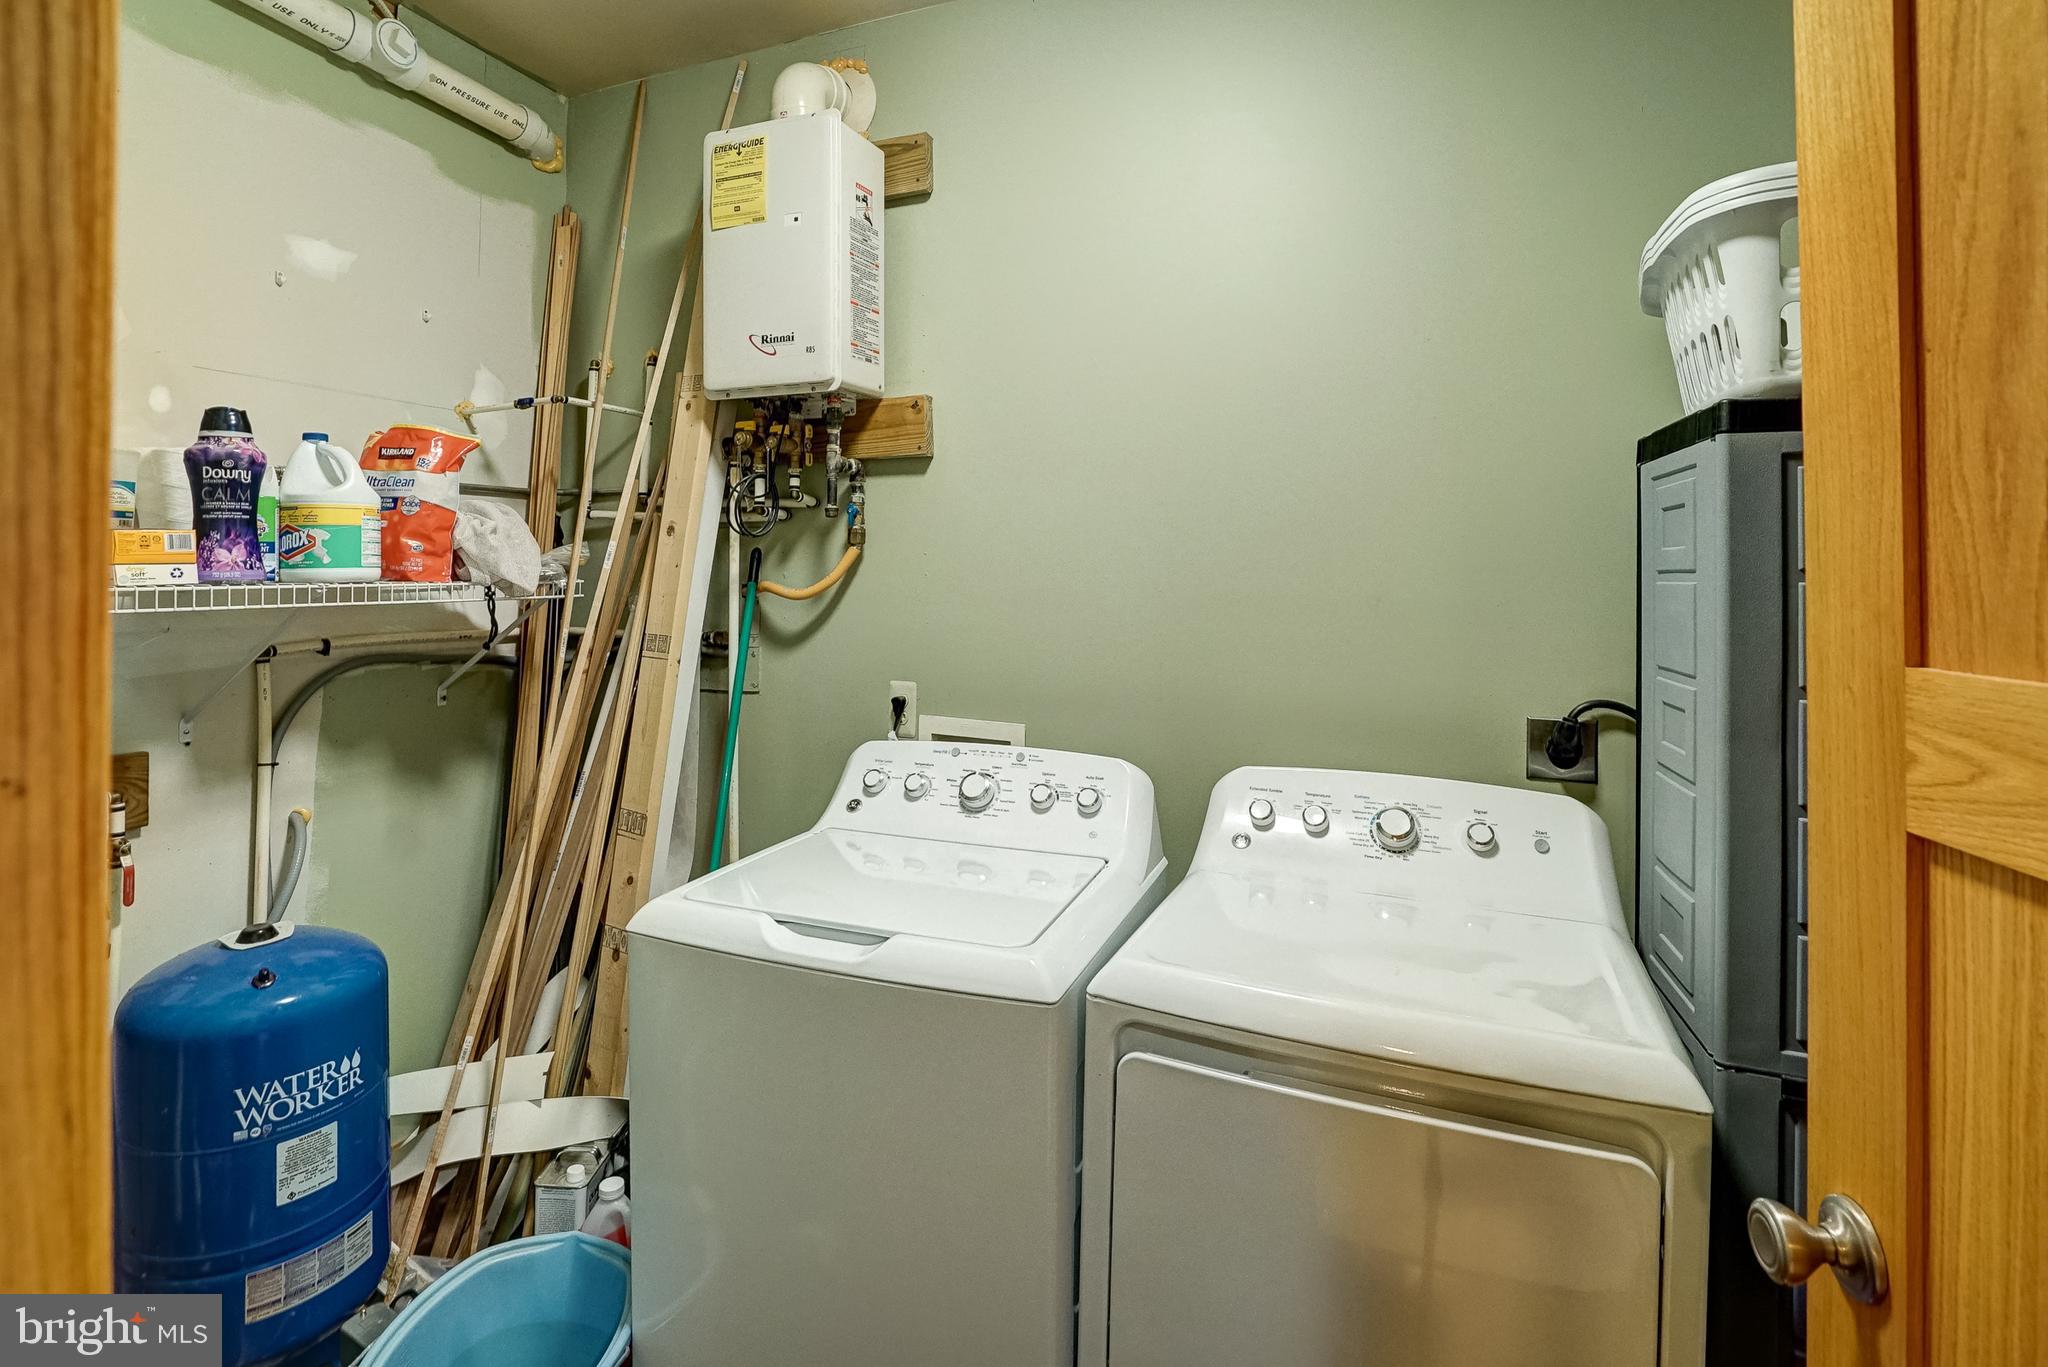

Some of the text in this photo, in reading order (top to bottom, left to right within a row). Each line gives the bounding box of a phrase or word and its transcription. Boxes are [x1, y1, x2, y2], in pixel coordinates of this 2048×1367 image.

[272, 2, 329, 34] USE ONLY
[450, 85, 491, 111] PRESSURE
[493, 108, 509, 121] USE
[511, 118, 526, 130] ONL
[761, 331, 795, 344] Rinnai
[380, 447, 415, 456] KIRKLAND
[202, 466, 252, 483] Downy
[201, 486, 251, 502] CALM
[280, 529, 310, 552] OROX
[233, 1060, 341, 1110] WATER
[233, 1067, 364, 1130] WORKER
